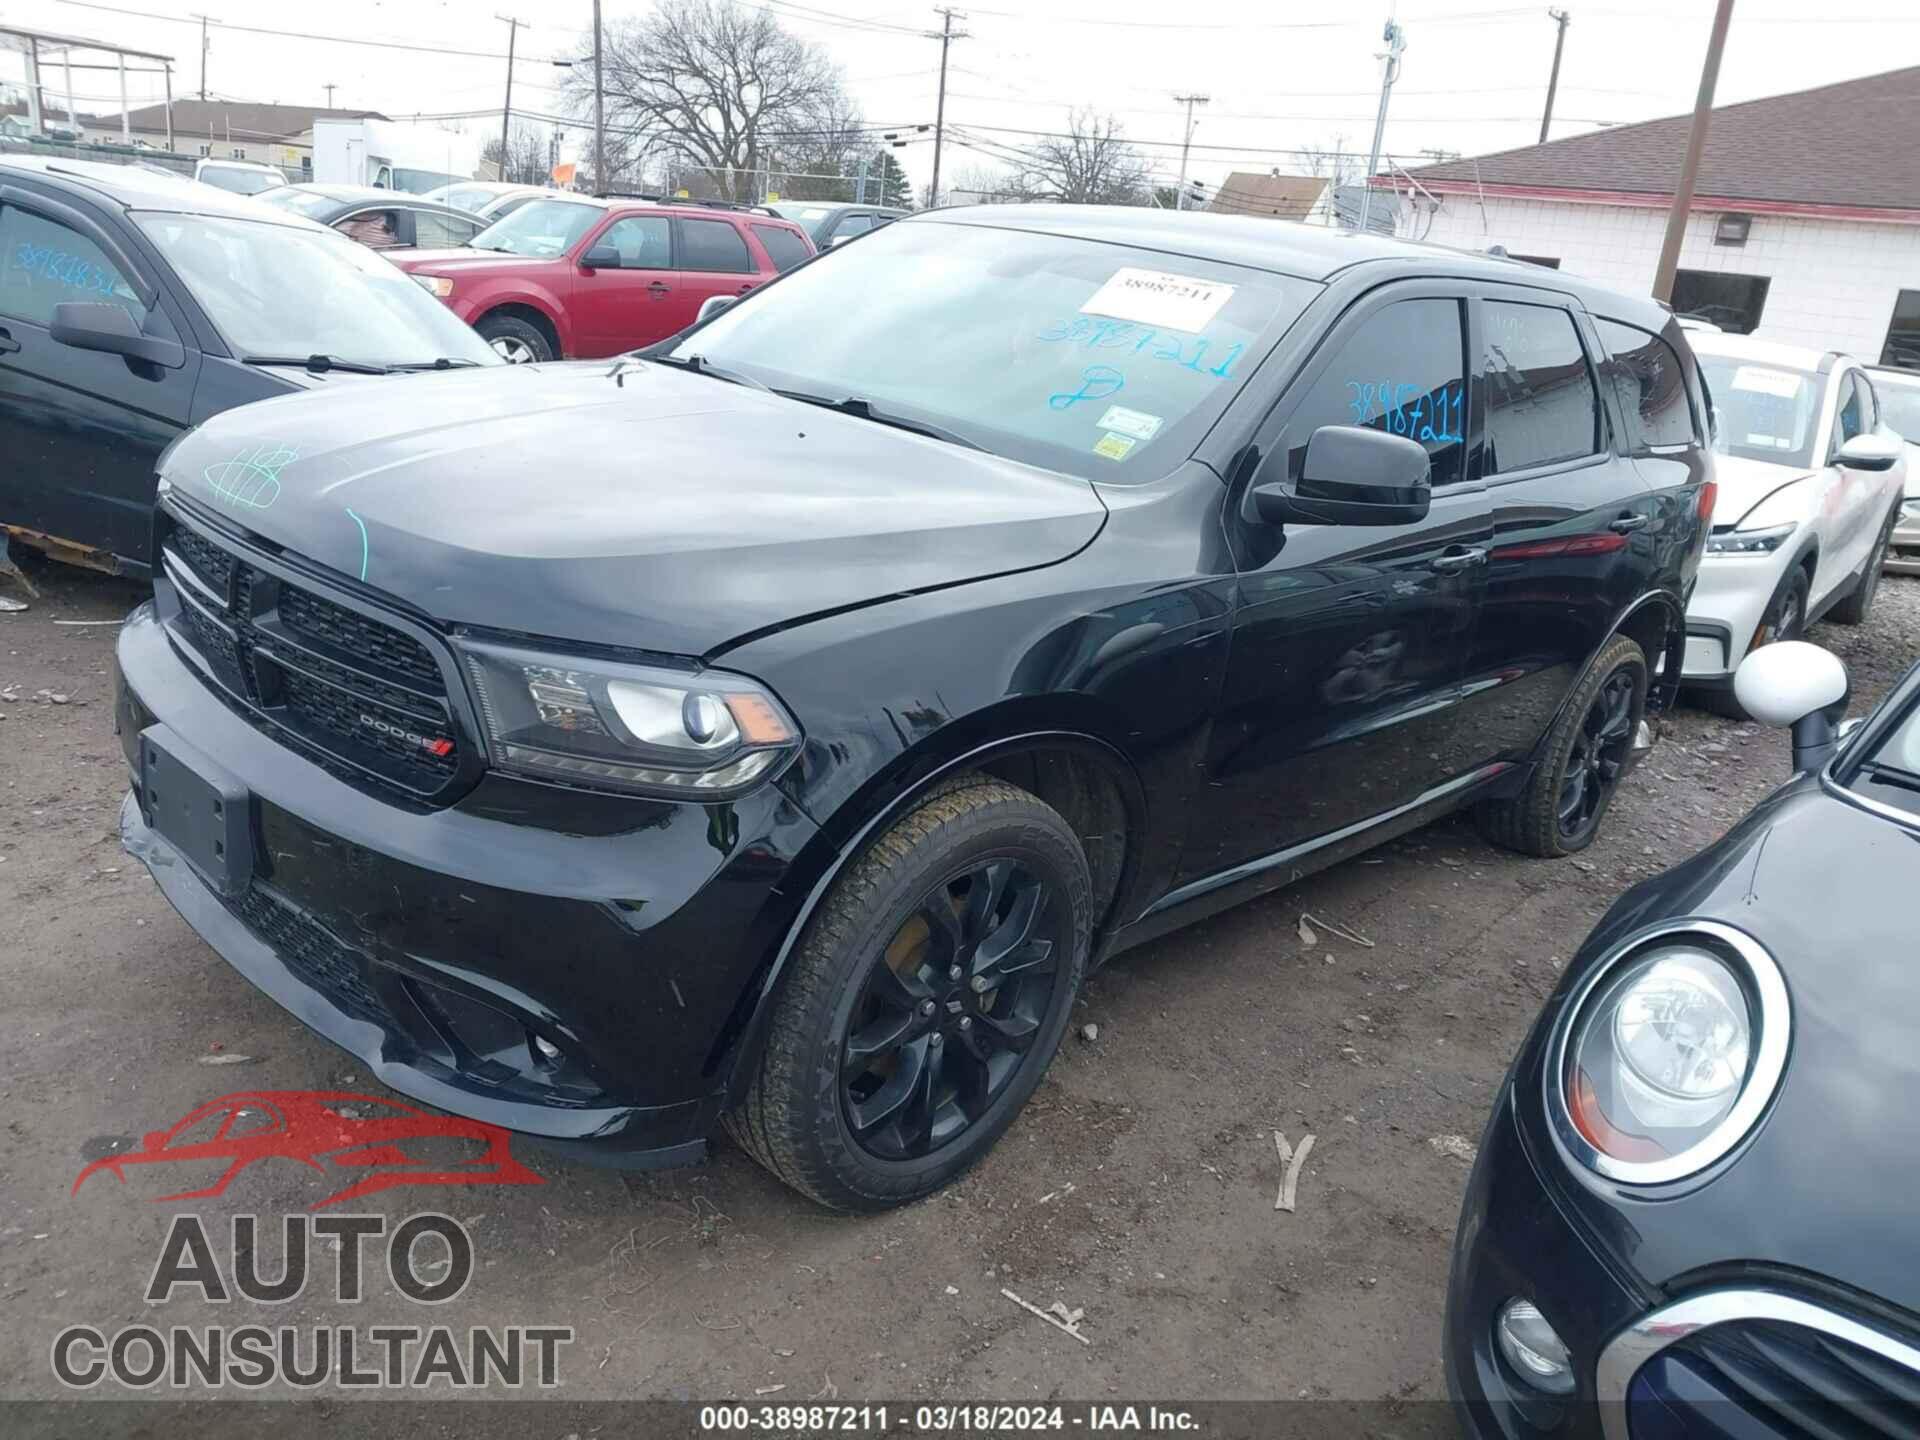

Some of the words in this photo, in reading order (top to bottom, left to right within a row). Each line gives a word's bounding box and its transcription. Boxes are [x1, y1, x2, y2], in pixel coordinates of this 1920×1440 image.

[1124, 277, 1213, 301] 38987211
[1037, 318, 1243, 380] 38987211
[1345, 380, 1464, 443] 38987211
[360, 714, 437, 752] DODGE
